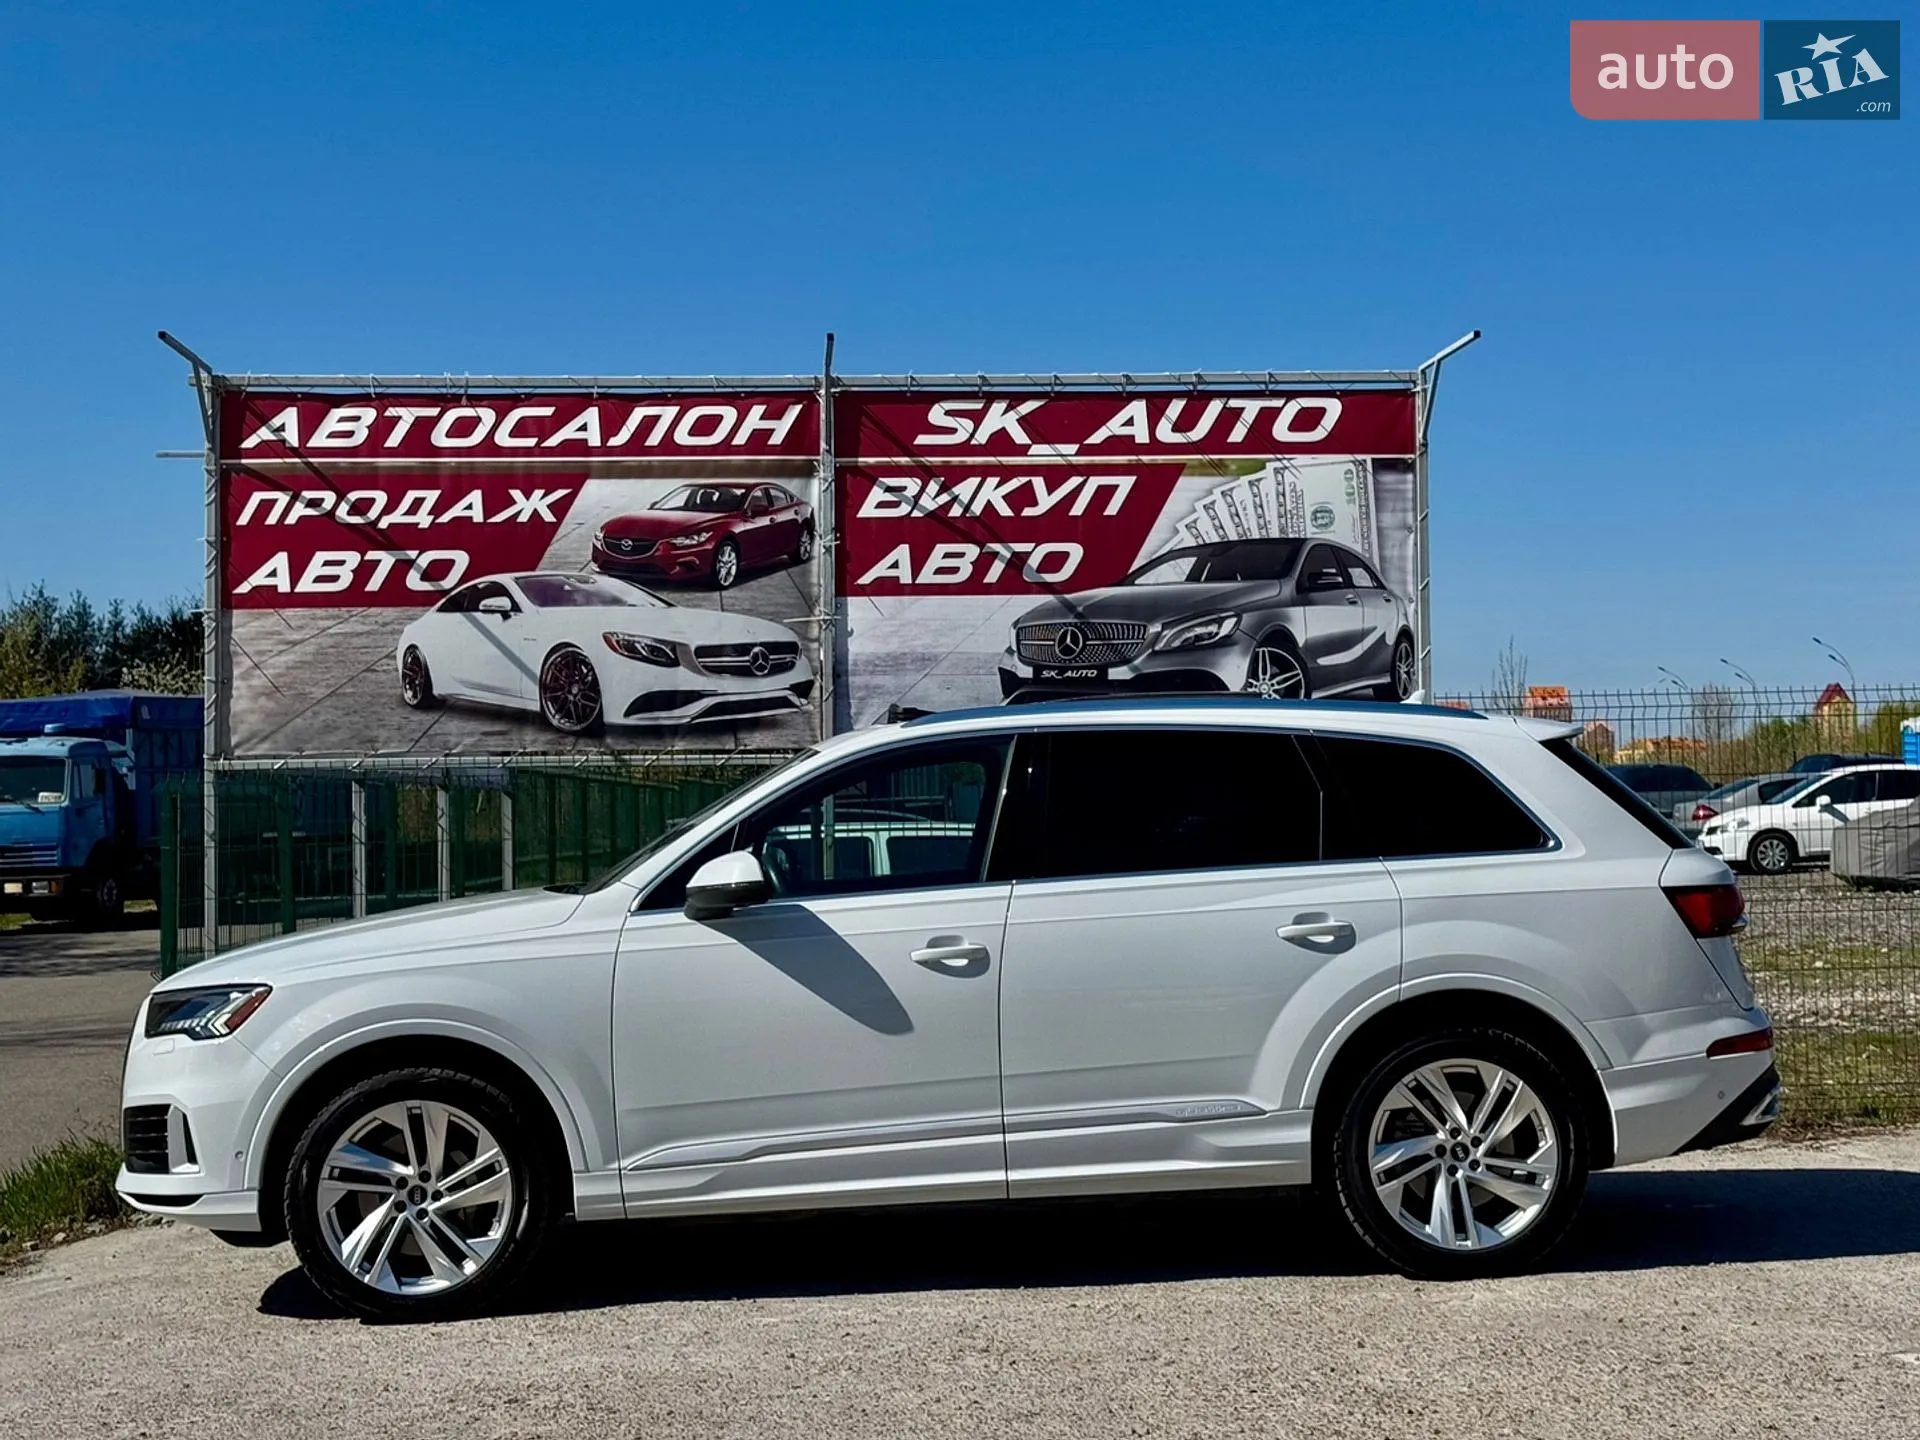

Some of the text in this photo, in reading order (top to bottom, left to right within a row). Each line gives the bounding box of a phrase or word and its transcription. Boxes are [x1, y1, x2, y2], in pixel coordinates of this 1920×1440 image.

[239, 404, 803, 449] АВТОСАЛОН
[913, 397, 1343, 455] SK_AUTO
[236, 488, 573, 530] ПРОДАЖ
[856, 475, 1138, 518] ВИКУП
[232, 549, 470, 594] АВТО
[856, 542, 1084, 585] АВТО
[1040, 669, 1098, 679] SK_AUTO
